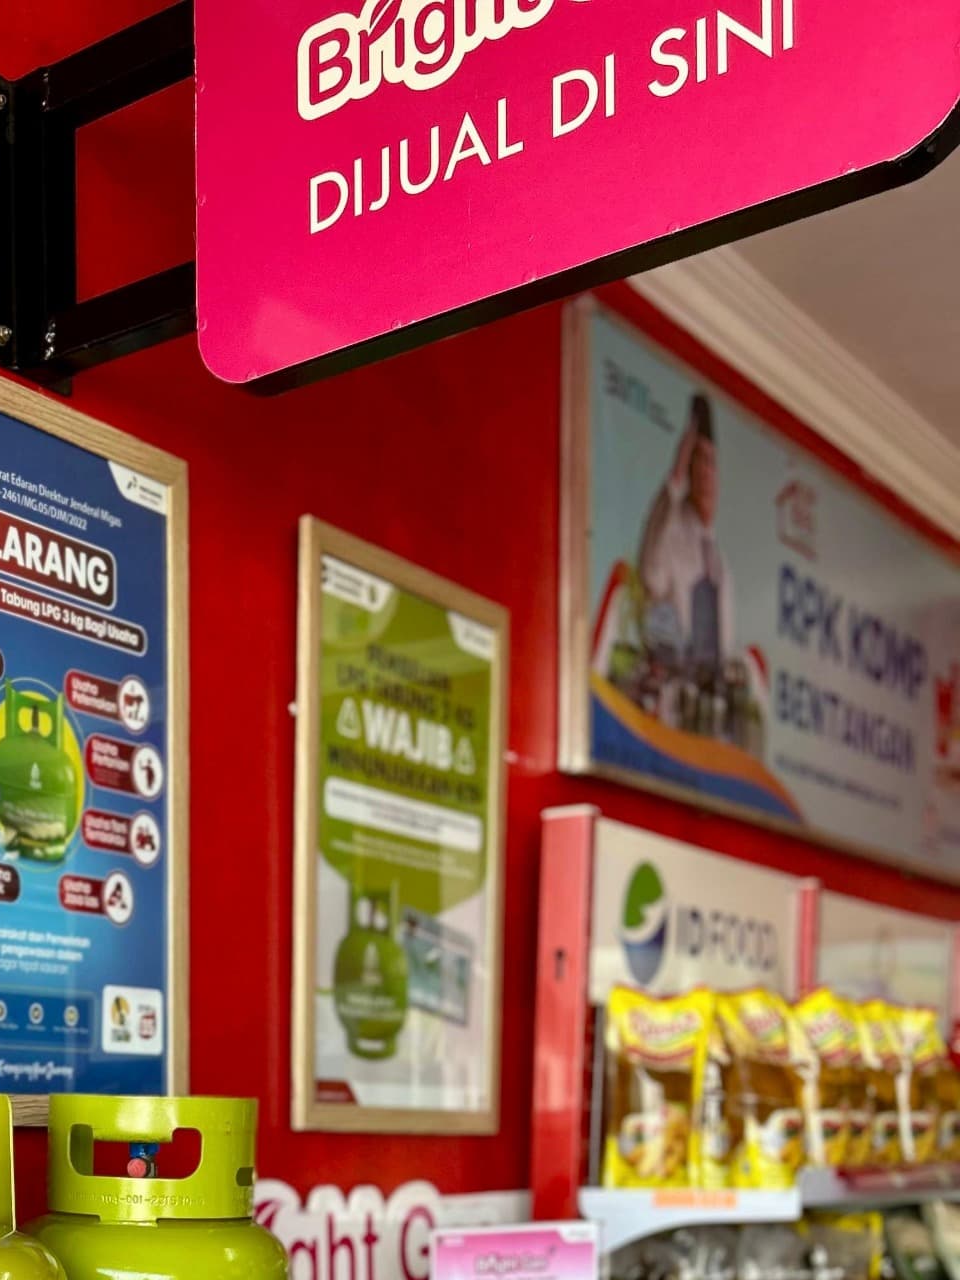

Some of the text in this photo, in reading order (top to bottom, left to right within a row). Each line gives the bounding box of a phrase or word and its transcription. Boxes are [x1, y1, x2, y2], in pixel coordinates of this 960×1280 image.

[310, 0, 795, 235] DIJUAL DI SINI
[11, 472, 38, 494] Edaran
[1, 588, 41, 617] Tabung
[41, 600, 61, 622] LPG
[70, 612, 84, 632] kg
[361, 699, 454, 771] WAJIB
